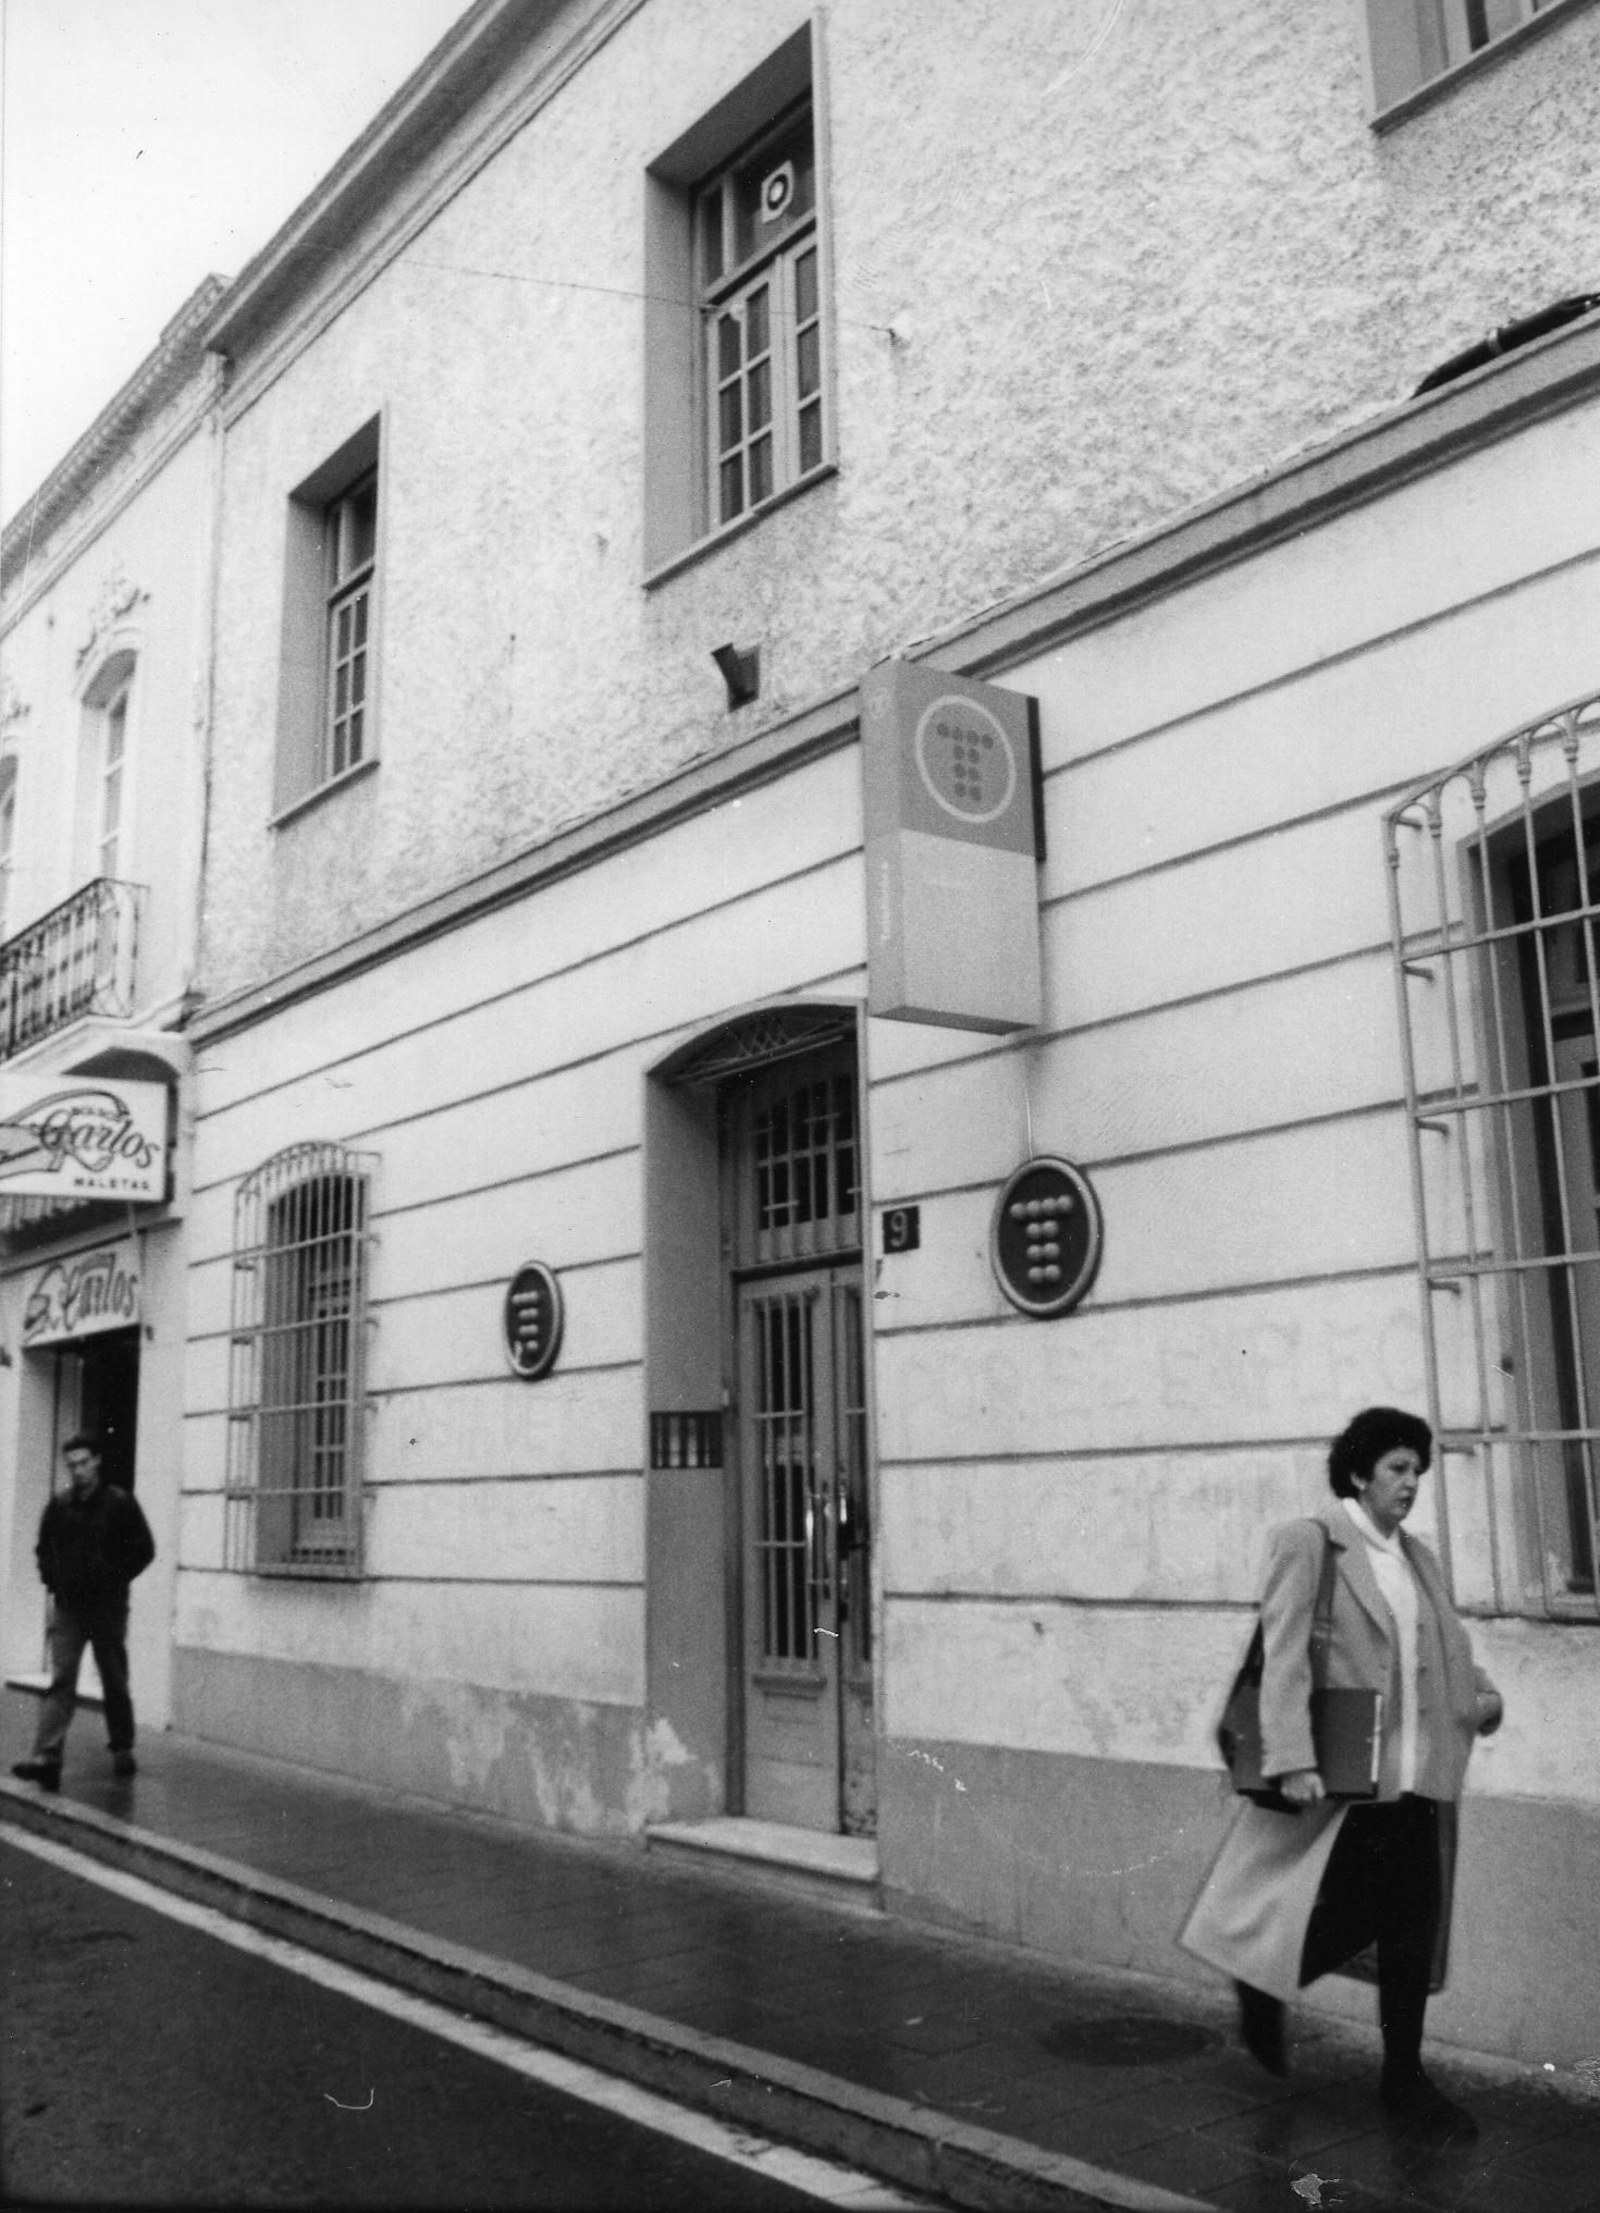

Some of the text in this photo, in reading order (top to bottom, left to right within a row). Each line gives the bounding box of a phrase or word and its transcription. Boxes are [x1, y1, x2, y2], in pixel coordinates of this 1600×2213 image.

[39, 1109, 160, 1168] Carlos
[73, 1178, 150, 1192] MALETAS
[890, 1210, 909, 1248] 9
